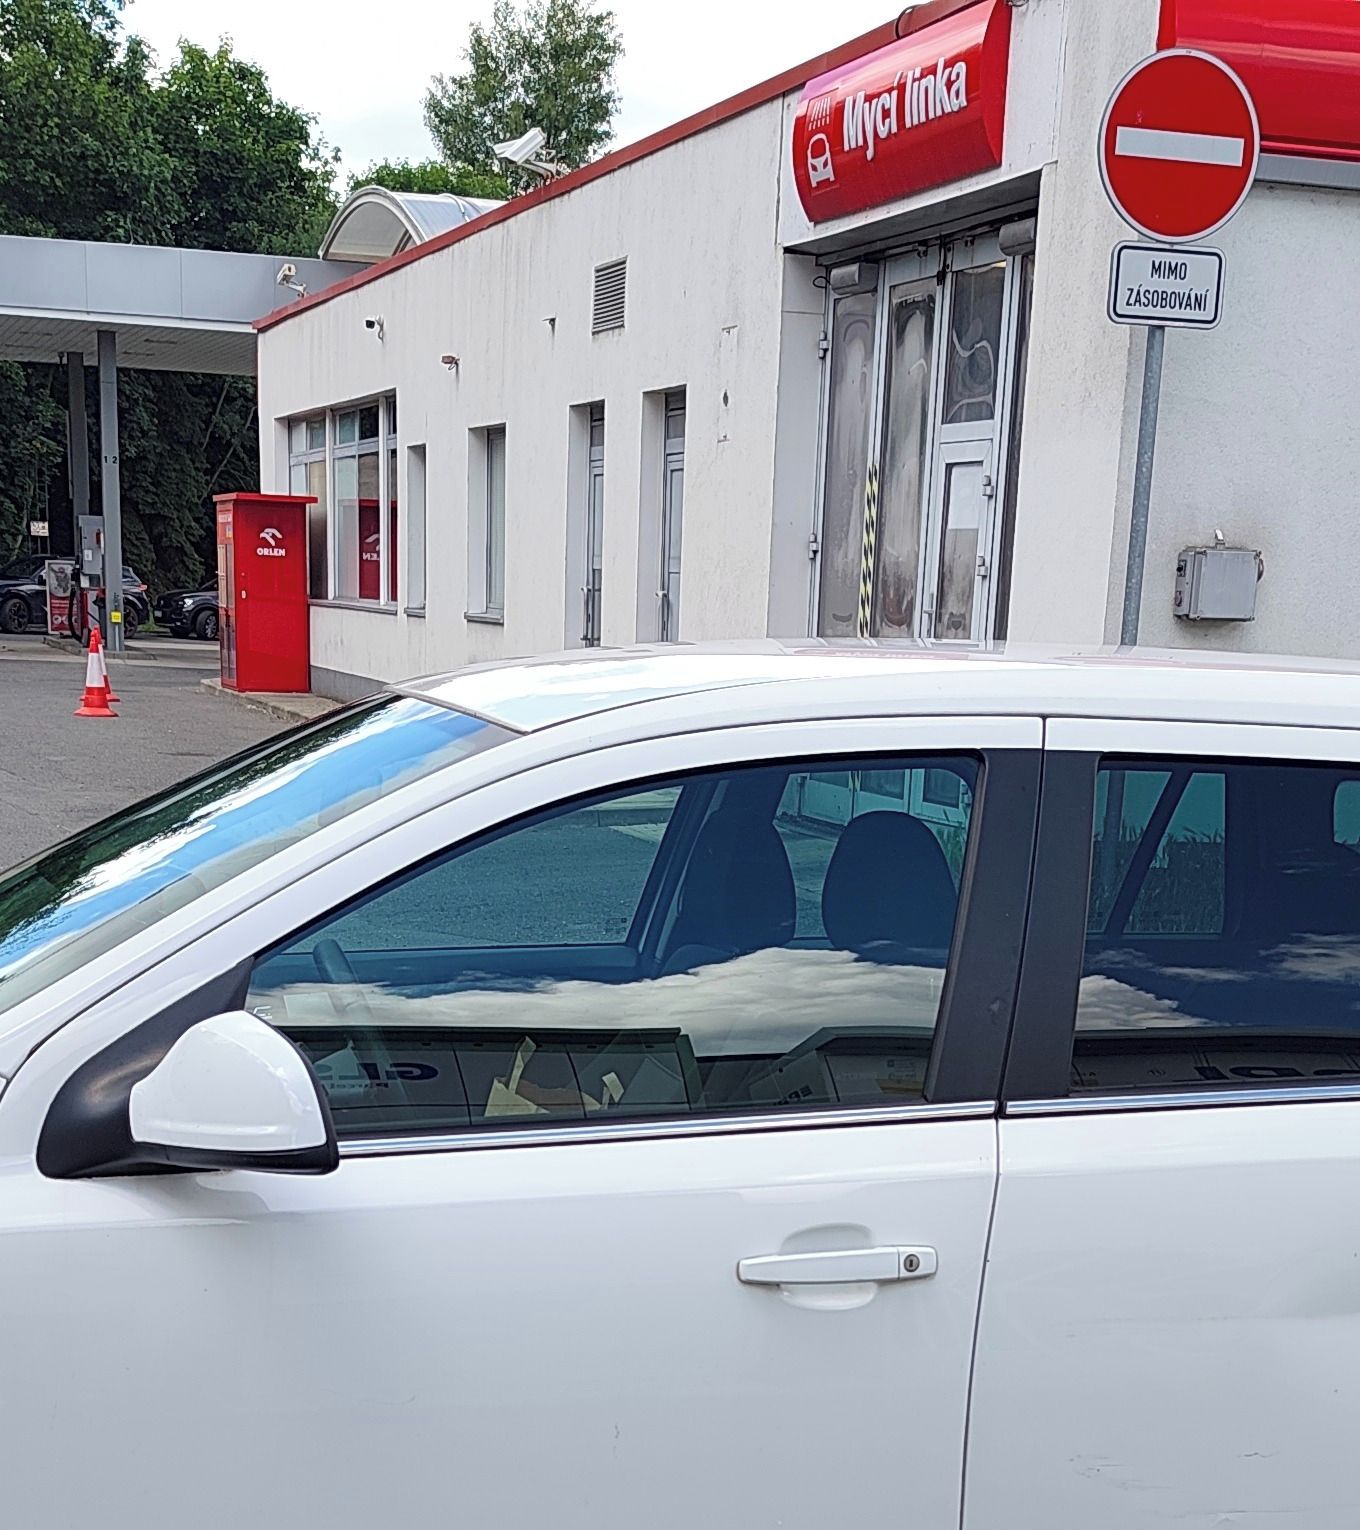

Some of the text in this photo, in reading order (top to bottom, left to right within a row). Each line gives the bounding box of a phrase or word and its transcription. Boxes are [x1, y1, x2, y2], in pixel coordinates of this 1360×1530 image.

[843, 57, 967, 161] Mycí linka
[1150, 259, 1188, 280] MIMO
[1125, 283, 1210, 312] ZÁSOBOVÁNÍ
[256, 547, 286, 557] ORLEN
